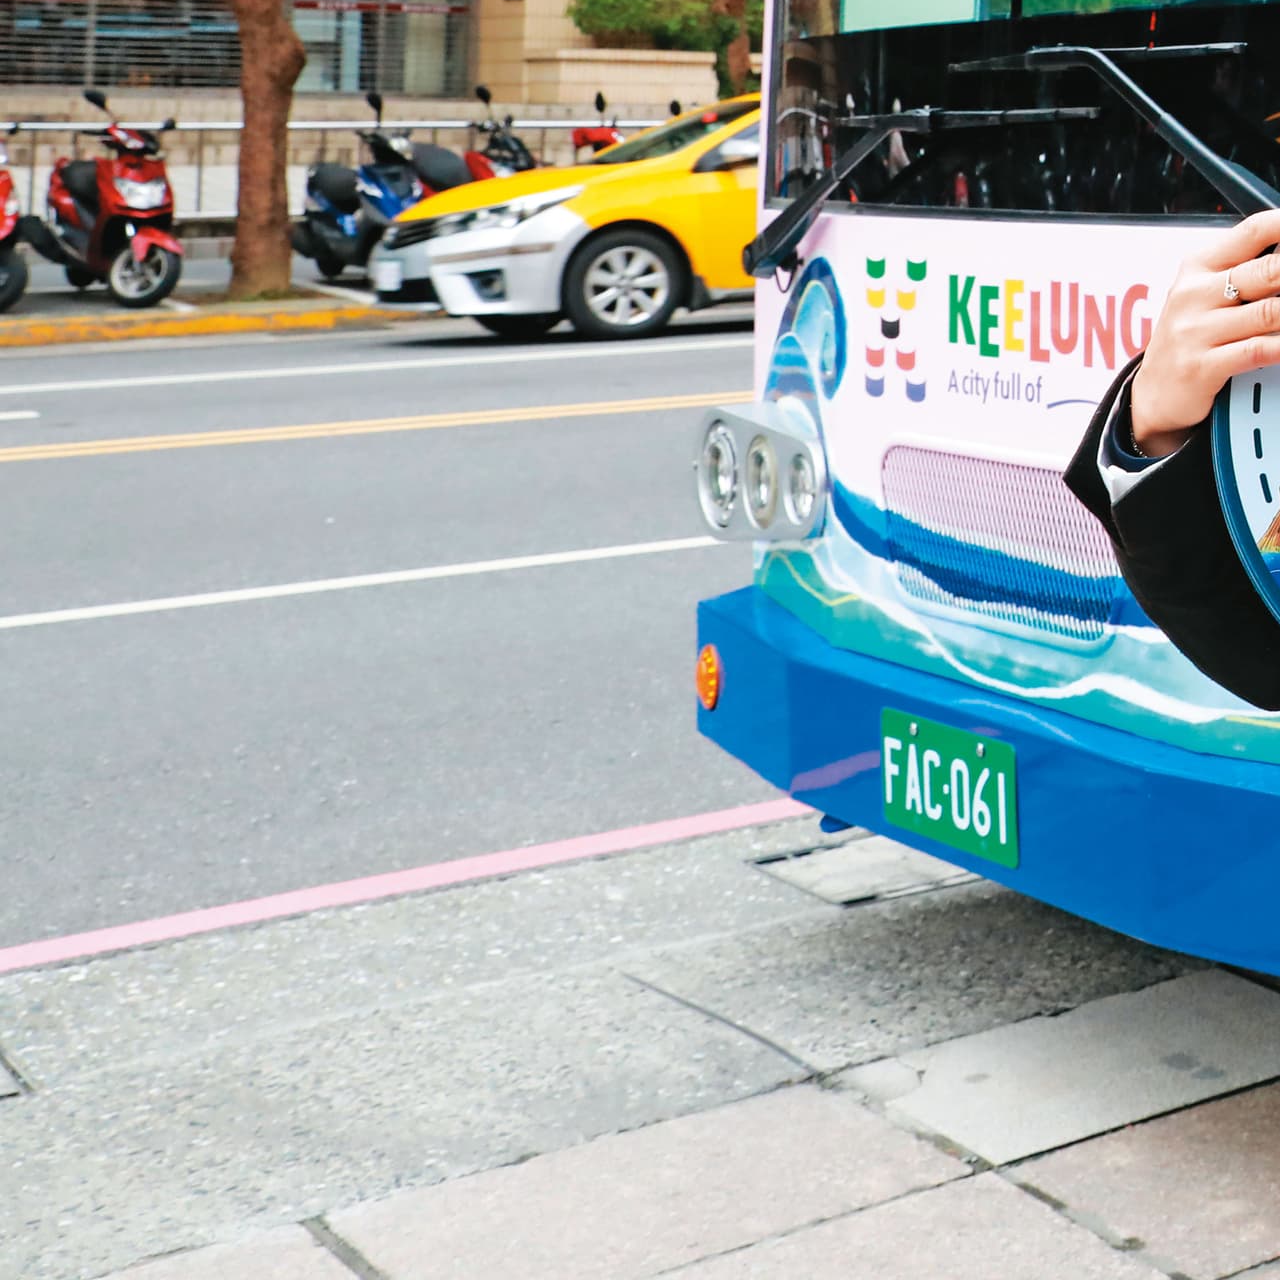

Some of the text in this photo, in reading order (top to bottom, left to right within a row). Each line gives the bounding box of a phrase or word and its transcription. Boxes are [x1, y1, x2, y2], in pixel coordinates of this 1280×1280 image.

[948, 274, 1153, 371] KEELUNG
[947, 368, 1043, 405] A city full of
